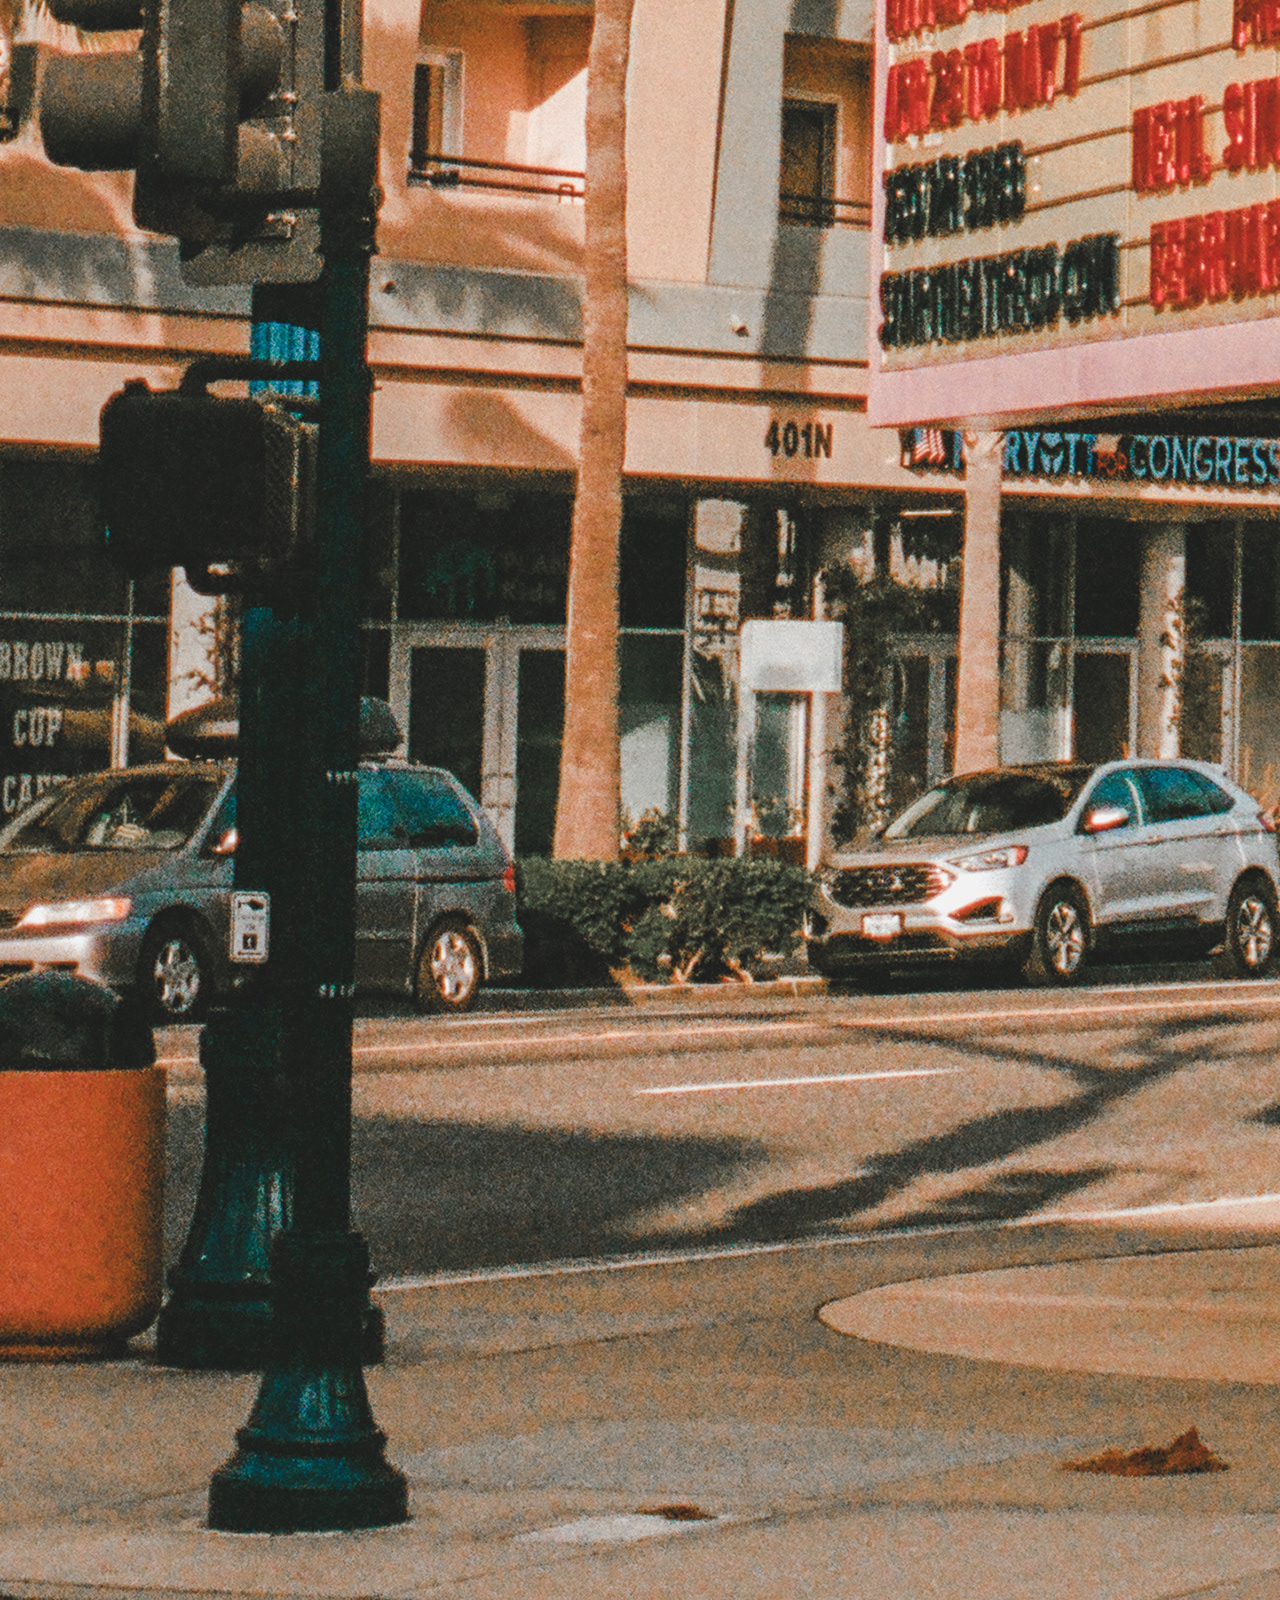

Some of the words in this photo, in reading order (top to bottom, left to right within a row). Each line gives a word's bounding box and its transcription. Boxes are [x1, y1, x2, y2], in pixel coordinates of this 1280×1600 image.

[964, 37, 1002, 120] TO
[1004, 21, 1060, 116] MAY
[1061, 13, 1082, 97] 7
[1132, 94, 1211, 196] NEIL
[764, 420, 833, 459] 401N
[13, 708, 64, 747] CUP
